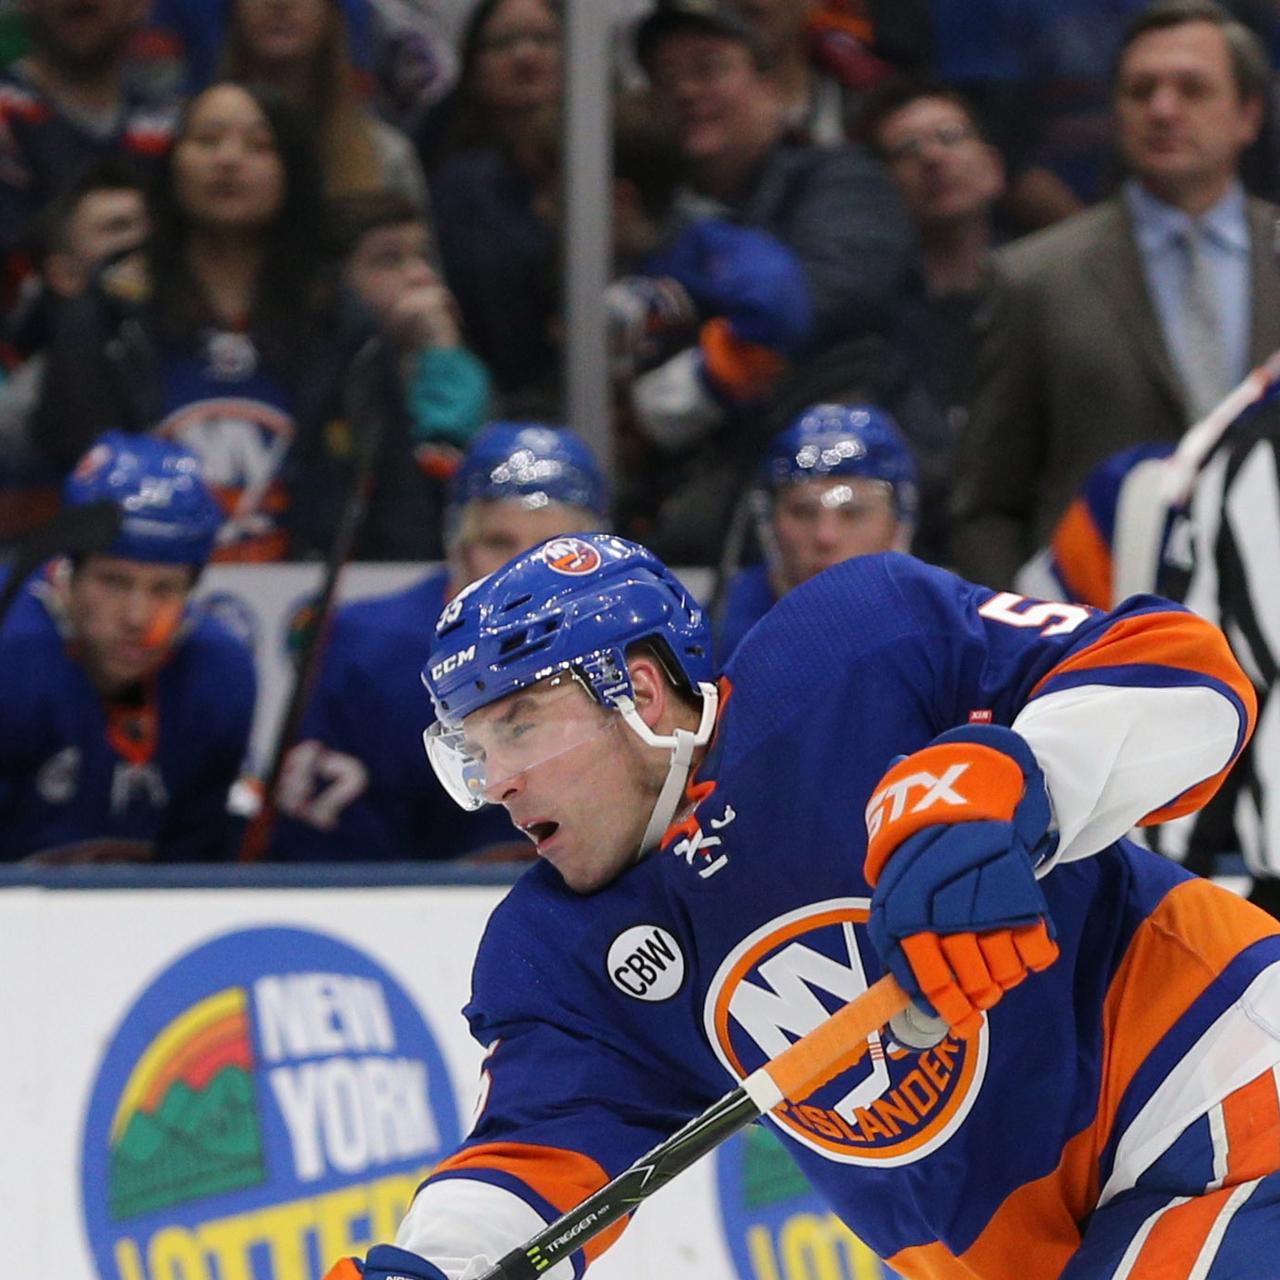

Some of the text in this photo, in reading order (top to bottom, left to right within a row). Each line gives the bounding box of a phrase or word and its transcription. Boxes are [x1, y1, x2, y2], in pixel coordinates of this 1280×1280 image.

[431, 645, 477, 682] CCM
[865, 763, 972, 844] STX
[613, 928, 677, 998] CBW
[254, 971, 397, 1060] NEW
[269, 1056, 442, 1182] YORK
[544, 1212, 599, 1254] TRIGGER
